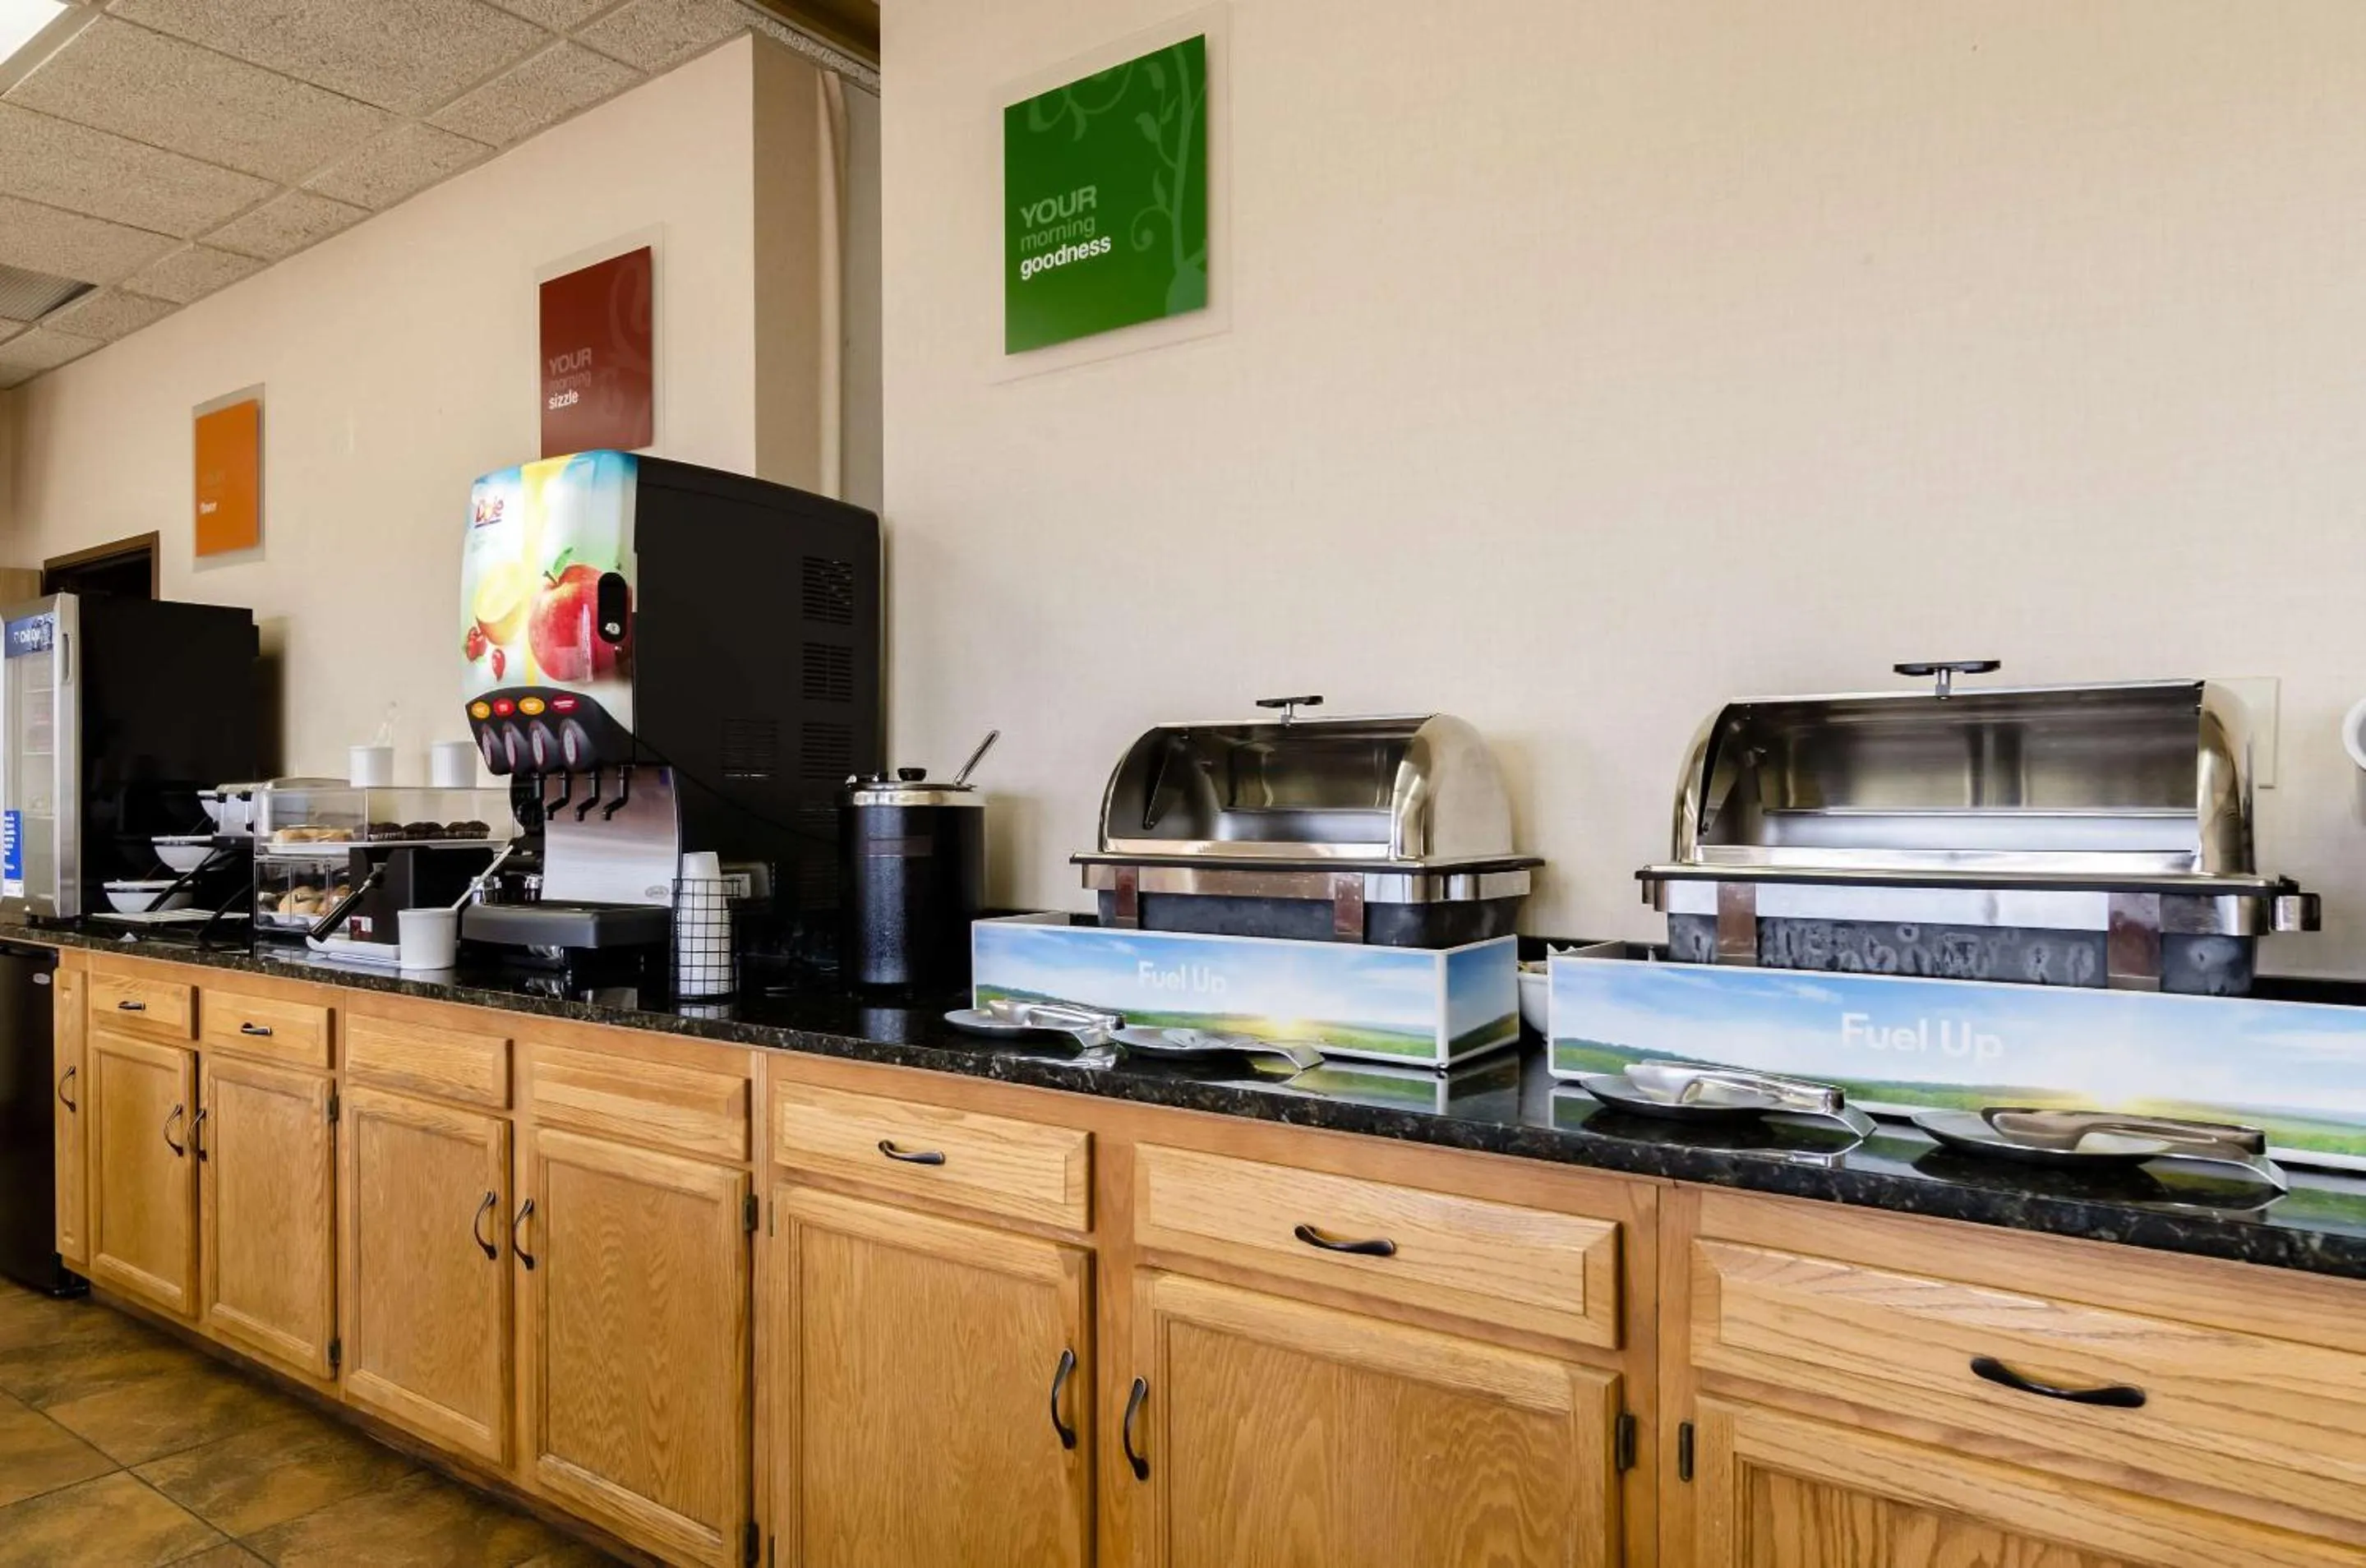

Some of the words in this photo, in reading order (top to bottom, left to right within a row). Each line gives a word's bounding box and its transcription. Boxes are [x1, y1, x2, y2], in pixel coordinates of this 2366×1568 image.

[1020, 185, 1097, 228] YOUR
[1021, 216, 1095, 252] morning
[1021, 236, 1111, 280] goodness
[549, 348, 592, 376] YOUR
[549, 389, 579, 409] sizzle
[1137, 960, 1187, 992] Fuel
[1191, 963, 1227, 995] Up
[1841, 1011, 1929, 1056] Fuel
[1940, 1018, 2004, 1069] Up
